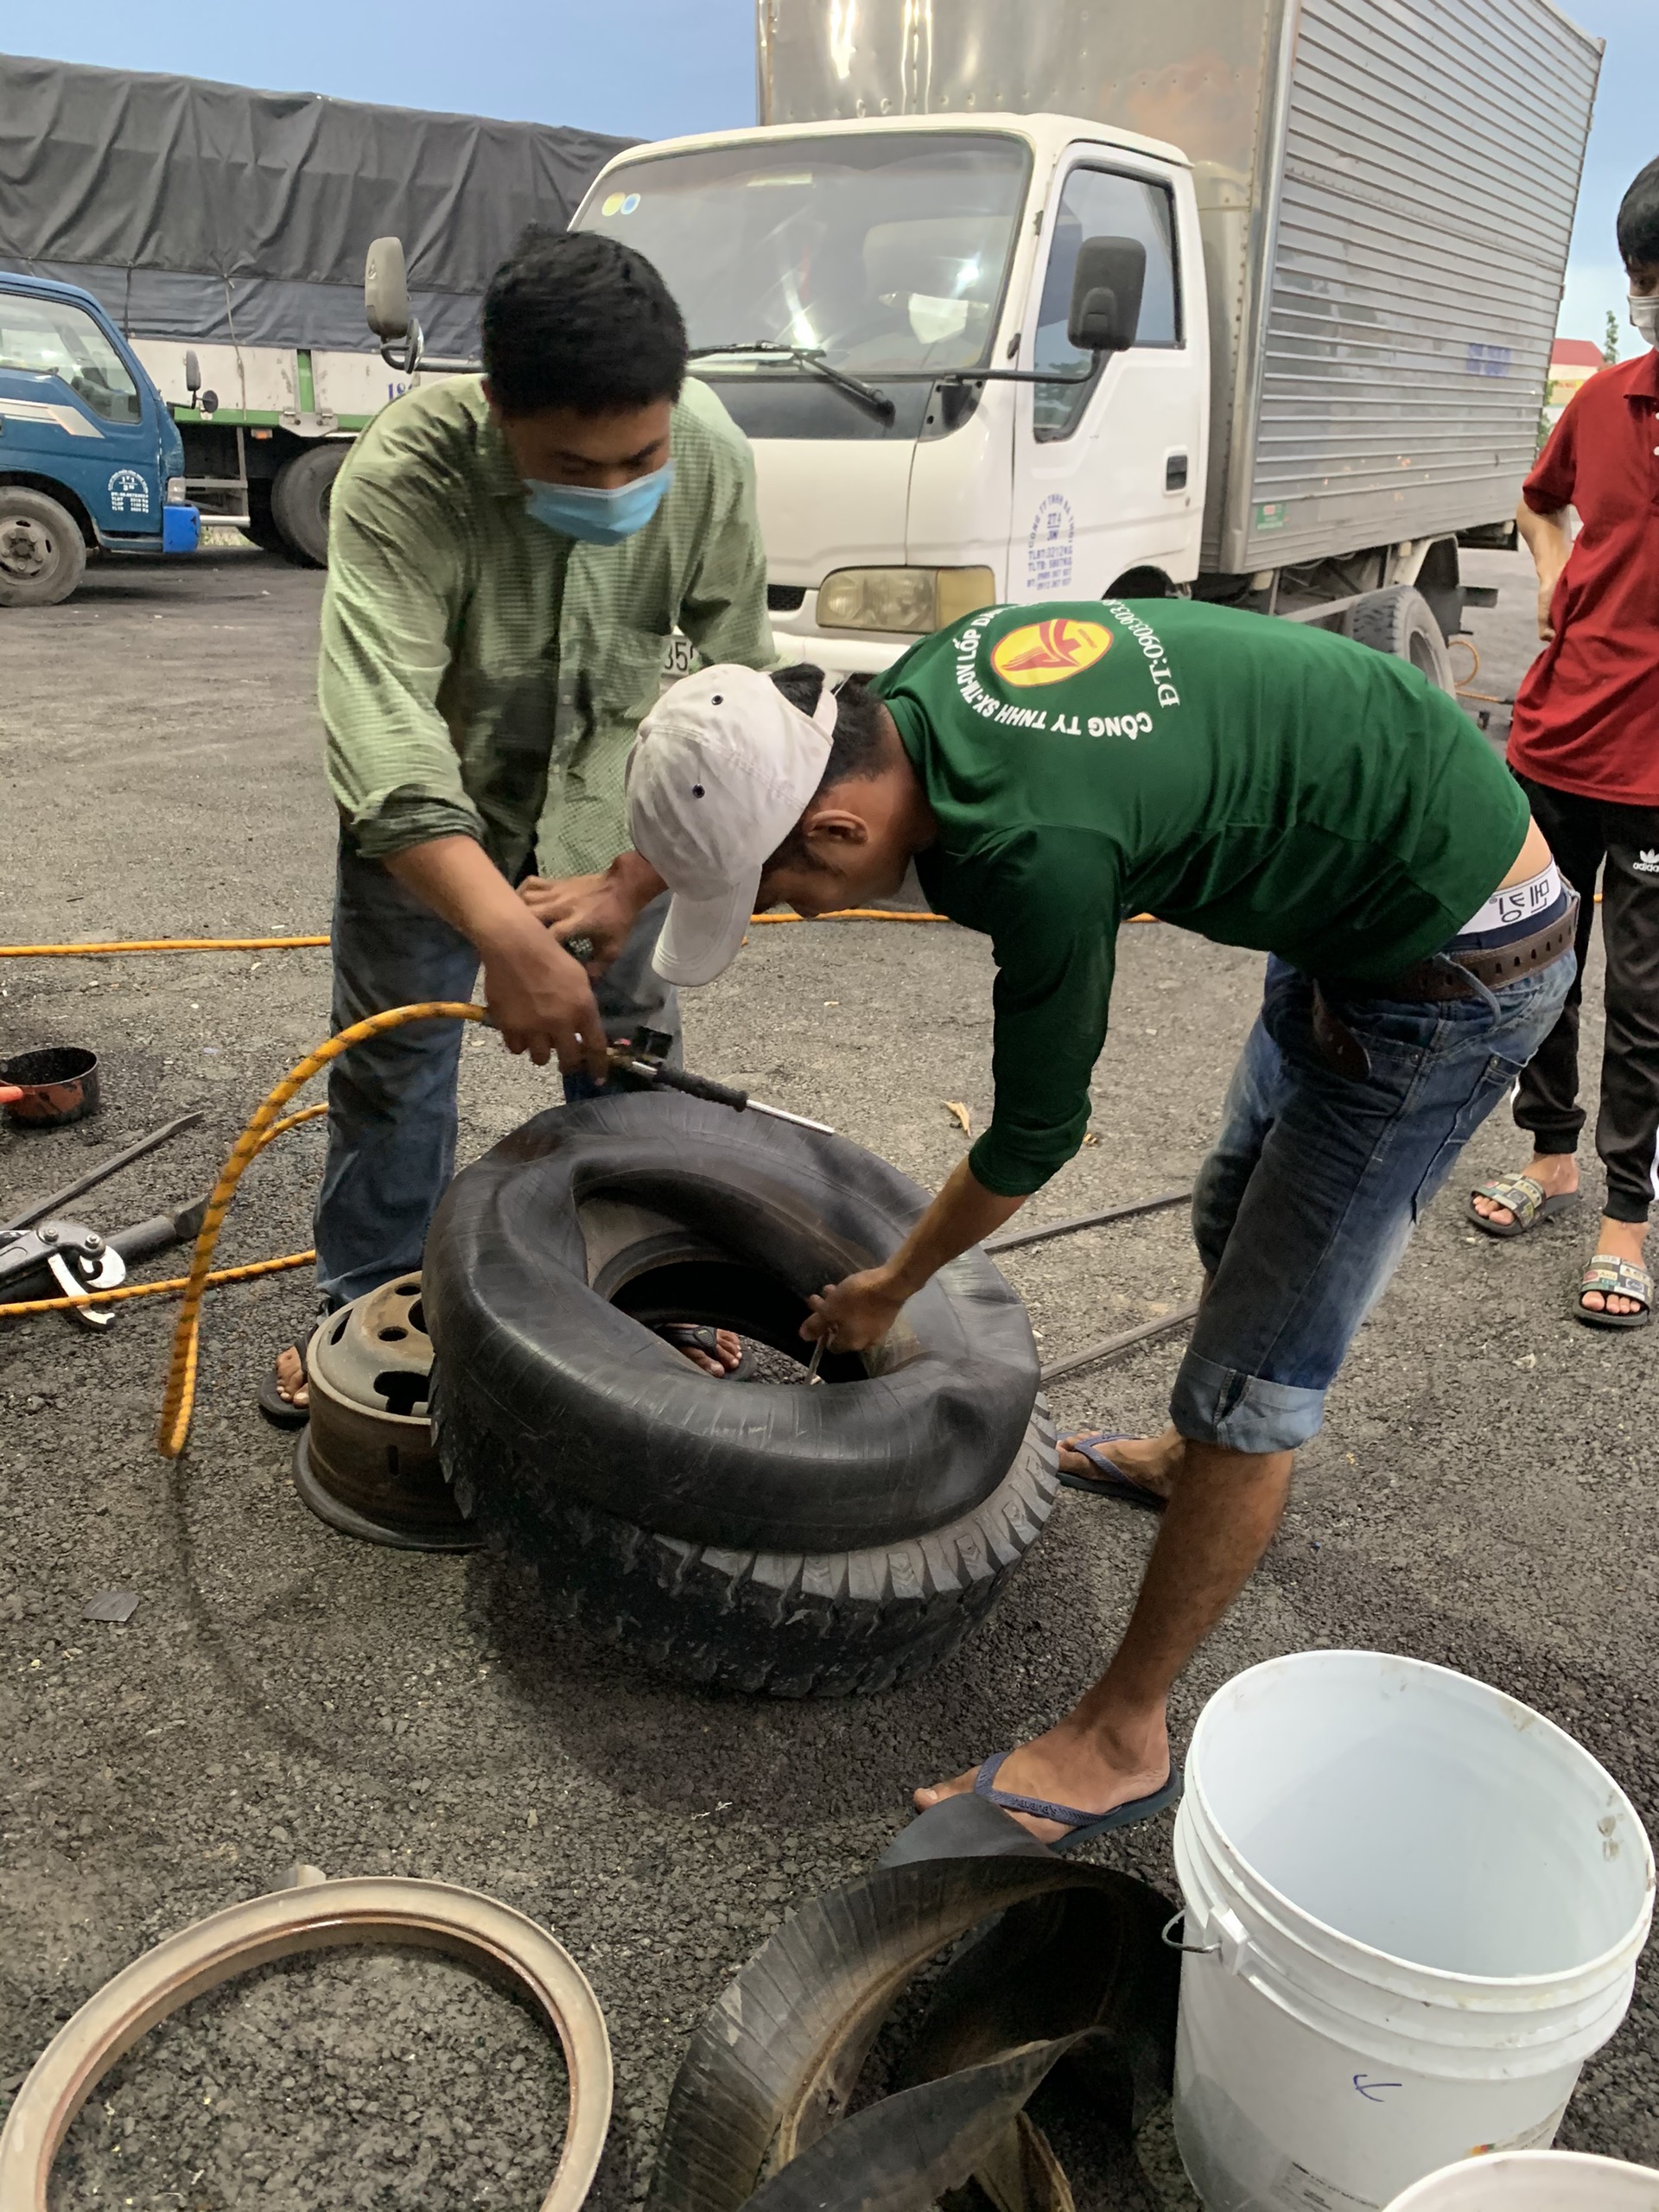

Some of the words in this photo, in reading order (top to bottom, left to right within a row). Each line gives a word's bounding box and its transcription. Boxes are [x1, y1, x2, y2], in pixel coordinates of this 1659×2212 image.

[952, 628, 982, 661] LỐP
[994, 703, 1047, 730] TNHH
[1050, 714, 1082, 735] TY
[1088, 711, 1154, 741] CÔNG
